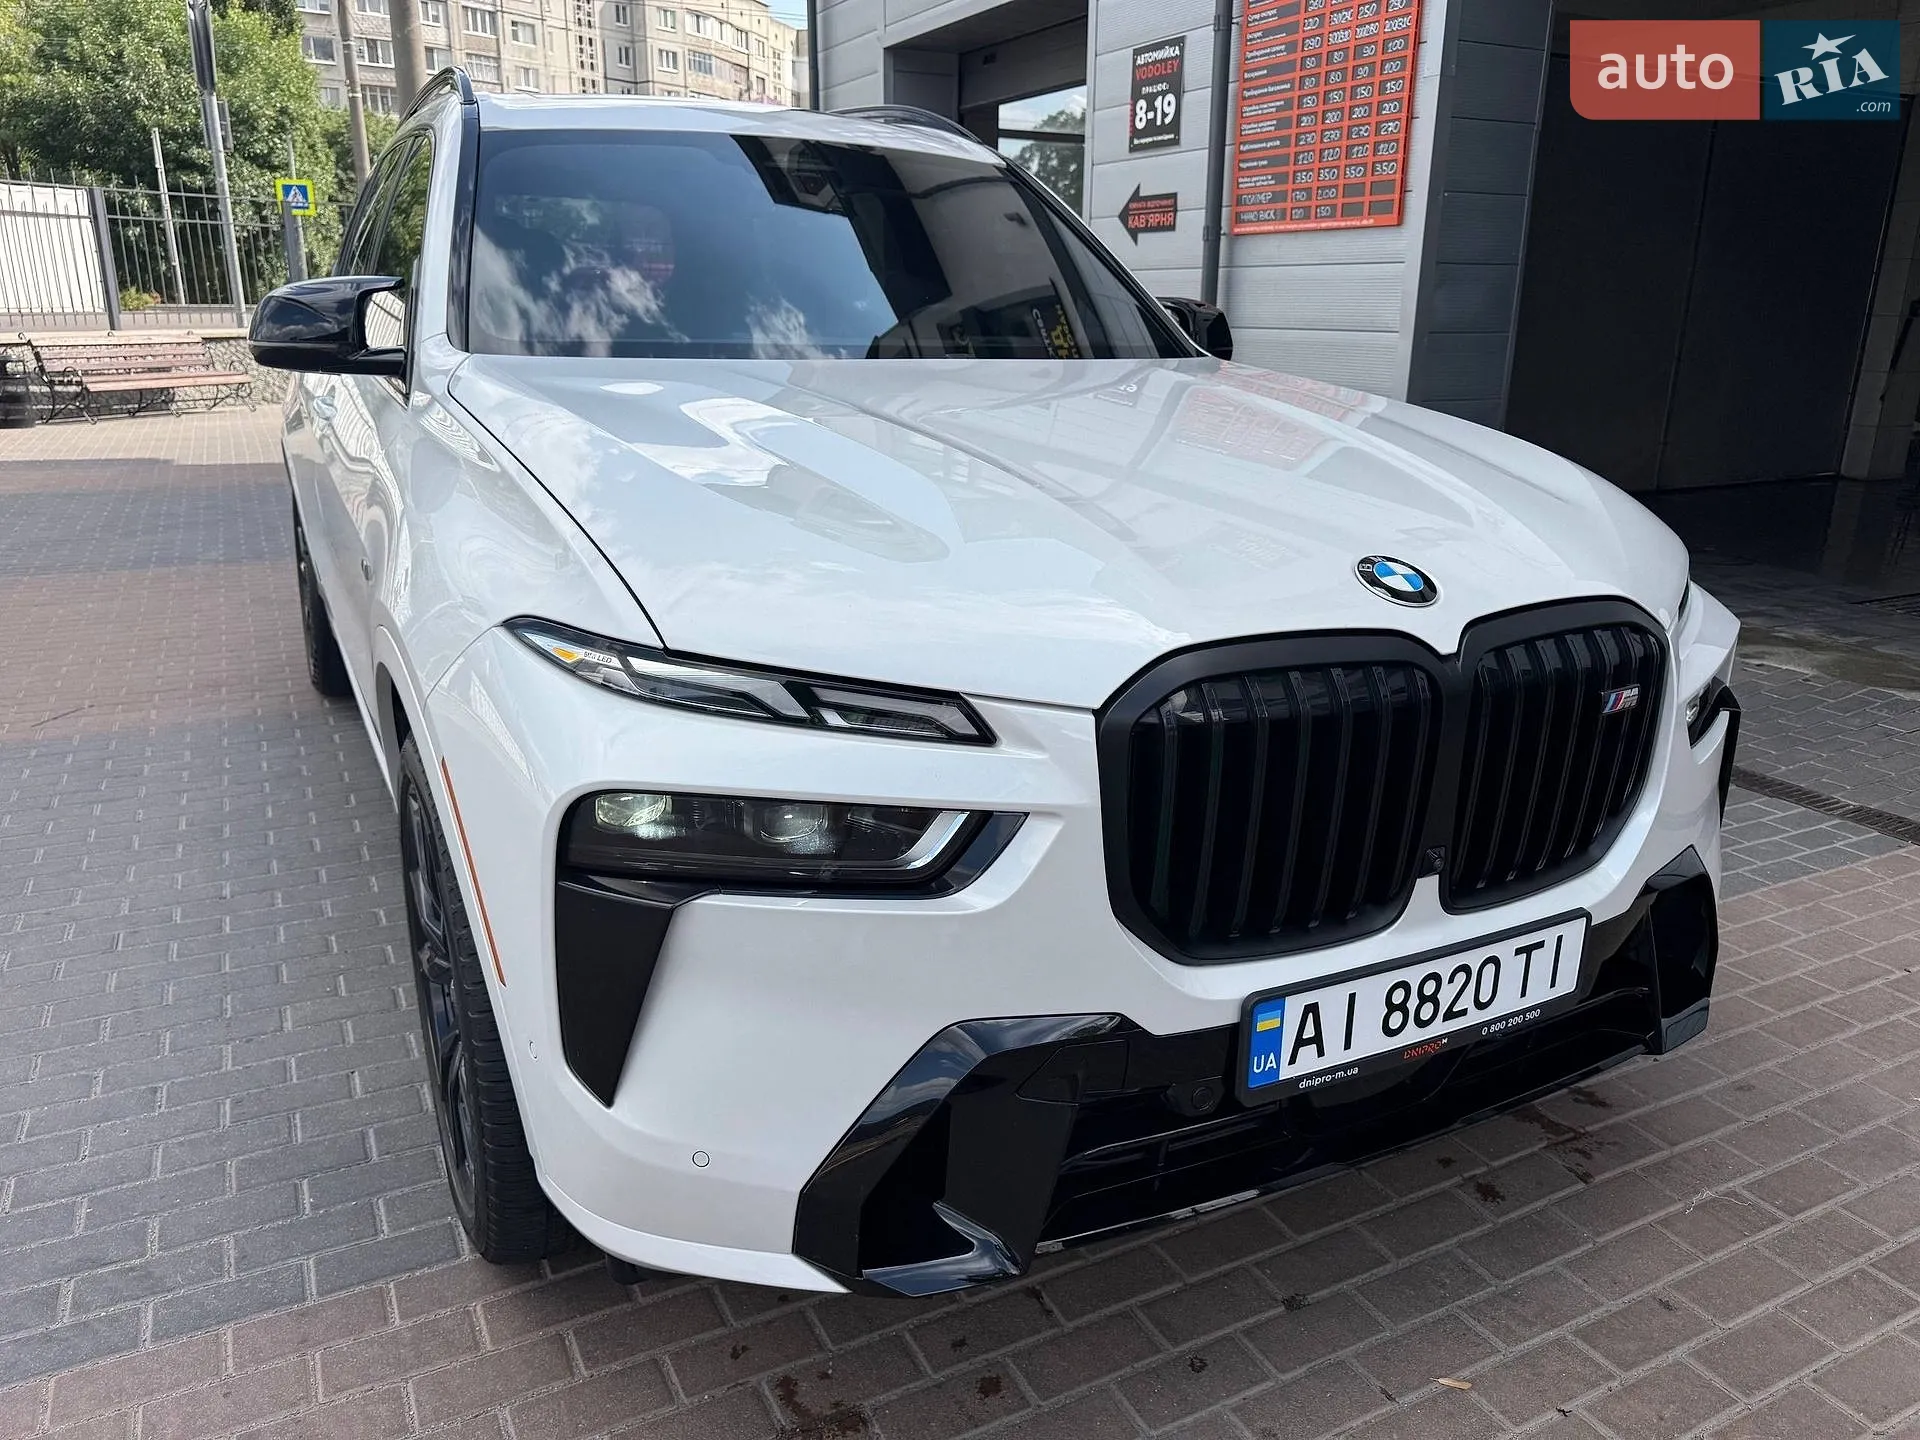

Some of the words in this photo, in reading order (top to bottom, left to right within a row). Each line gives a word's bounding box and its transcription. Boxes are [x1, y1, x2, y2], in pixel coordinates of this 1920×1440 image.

[1387, 39, 1405, 53] 100
[1136, 45, 1180, 66] АВТОМИЙКА
[1135, 59, 1180, 80] VODOLEY
[1383, 61, 1401, 74] 100
[1356, 86, 1372, 99] 150
[1386, 80, 1403, 94] 150
[1135, 93, 1176, 129] 8-19
[1319, 168, 1338, 181] 350
[1345, 166, 1364, 178] 350
[1375, 162, 1397, 175] 350
[1295, 172, 1313, 184] 350
[1128, 212, 1173, 228] КАВ'ЯРНЯ
[1288, 992, 1356, 1066] AI
[1381, 954, 1502, 1038] 8820
[1514, 934, 1564, 999] TI
[1481, 1026, 1488, 1036] 0
[1489, 1021, 1506, 1034] 800
[1507, 1015, 1525, 1028] 200
[1525, 1009, 1541, 1022] 500
[1253, 1052, 1278, 1074] UA
[1299, 1065, 1359, 1089] dnipro-m.ua
